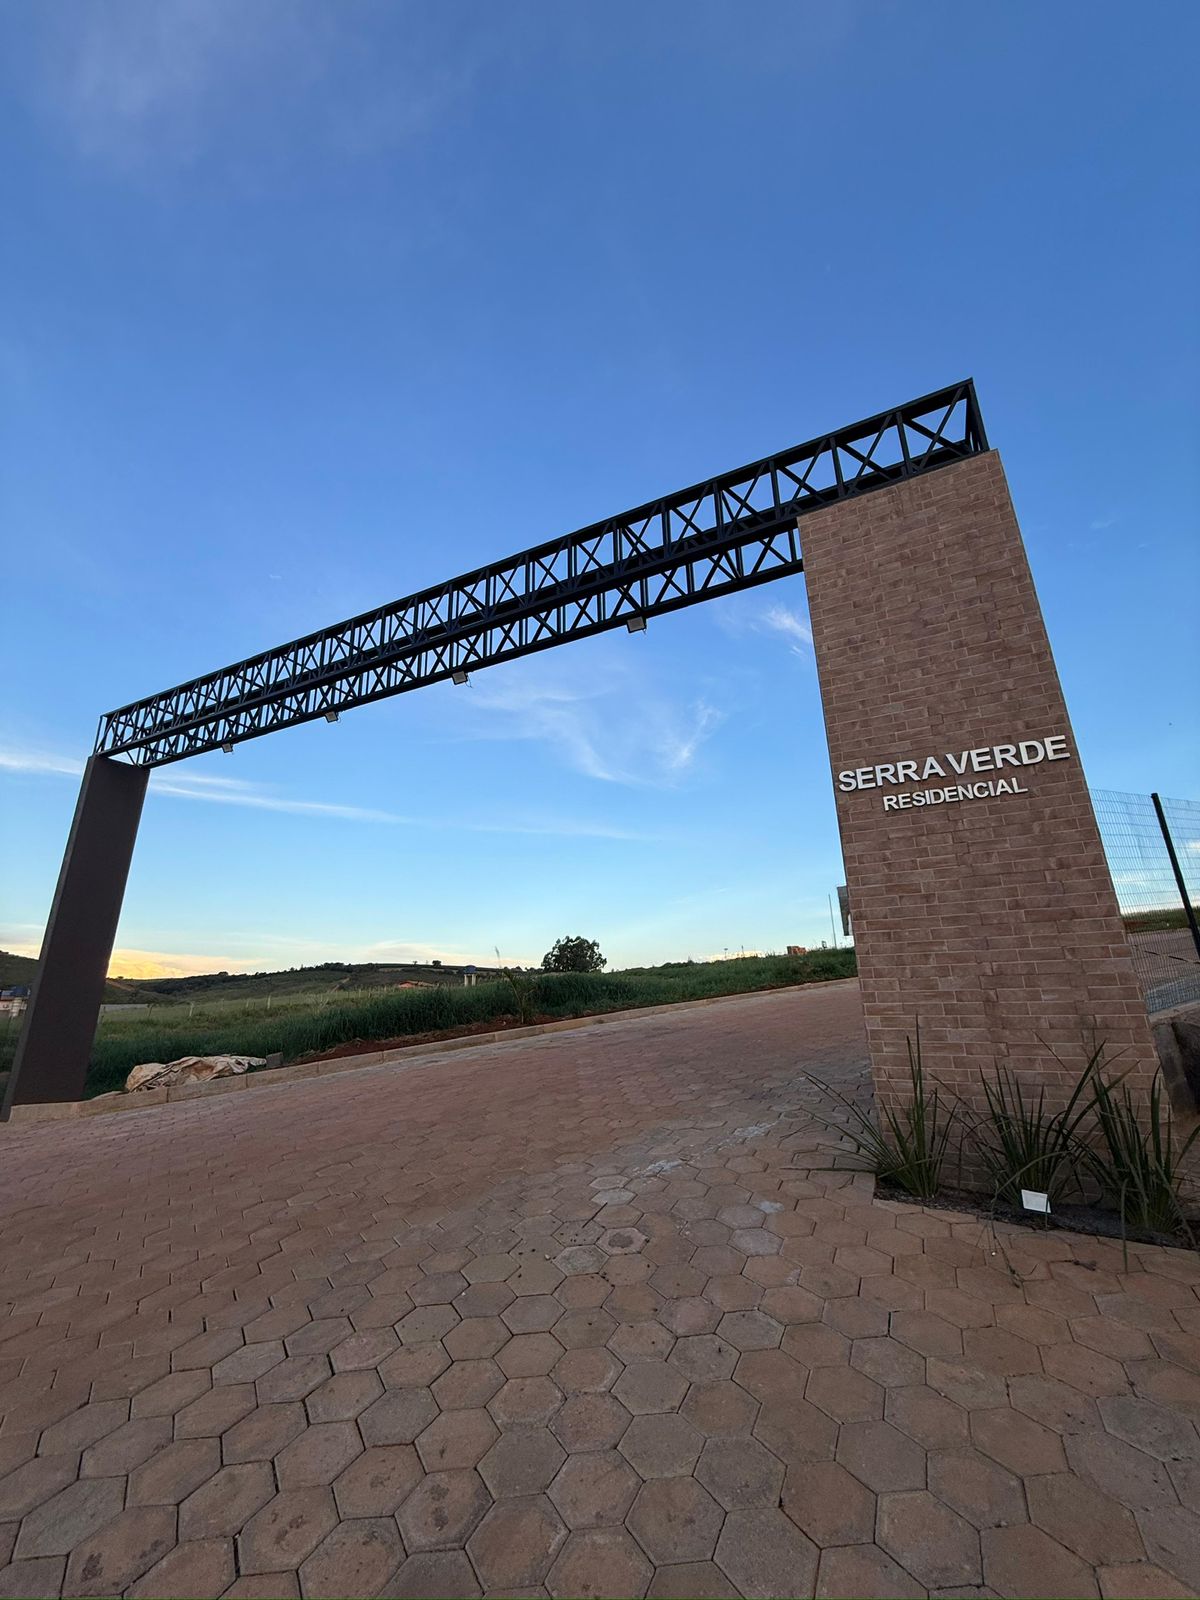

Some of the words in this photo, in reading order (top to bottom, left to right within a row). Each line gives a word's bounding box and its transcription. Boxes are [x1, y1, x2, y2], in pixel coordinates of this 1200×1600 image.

[838, 756, 947, 792] SERRA
[946, 735, 1071, 775] VERDE
[883, 777, 1028, 811] RESIDENCIAL
